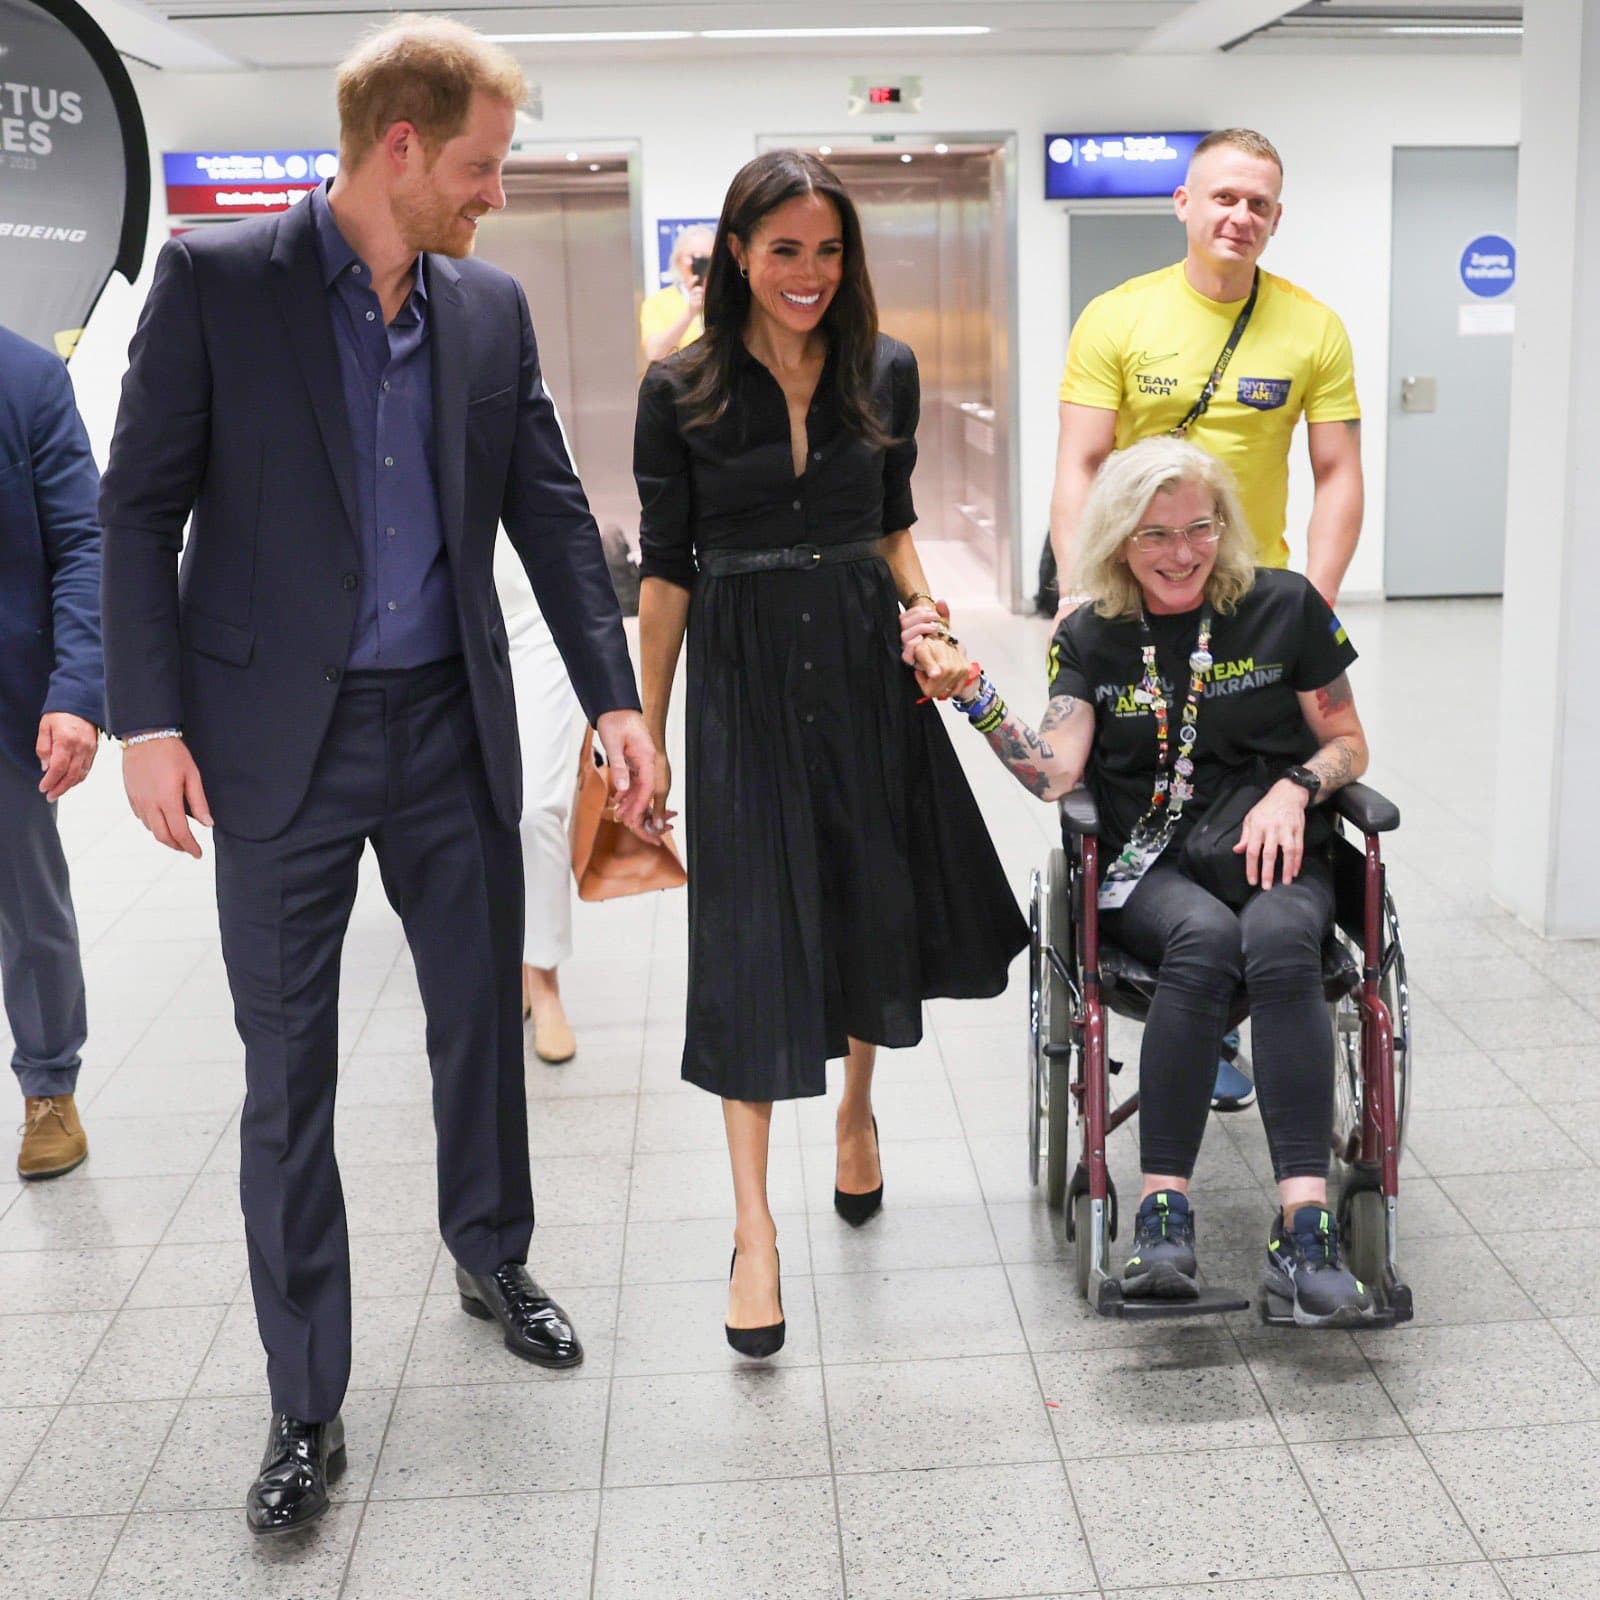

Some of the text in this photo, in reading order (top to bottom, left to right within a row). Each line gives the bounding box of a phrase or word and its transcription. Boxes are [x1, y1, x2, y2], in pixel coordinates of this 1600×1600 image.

[0, 83, 83, 124] TUS
[0, 117, 52, 155] ES
[0, 223, 87, 242] BOEING
[1135, 374, 1178, 386] TEAM
[1138, 384, 1170, 395] UKR
